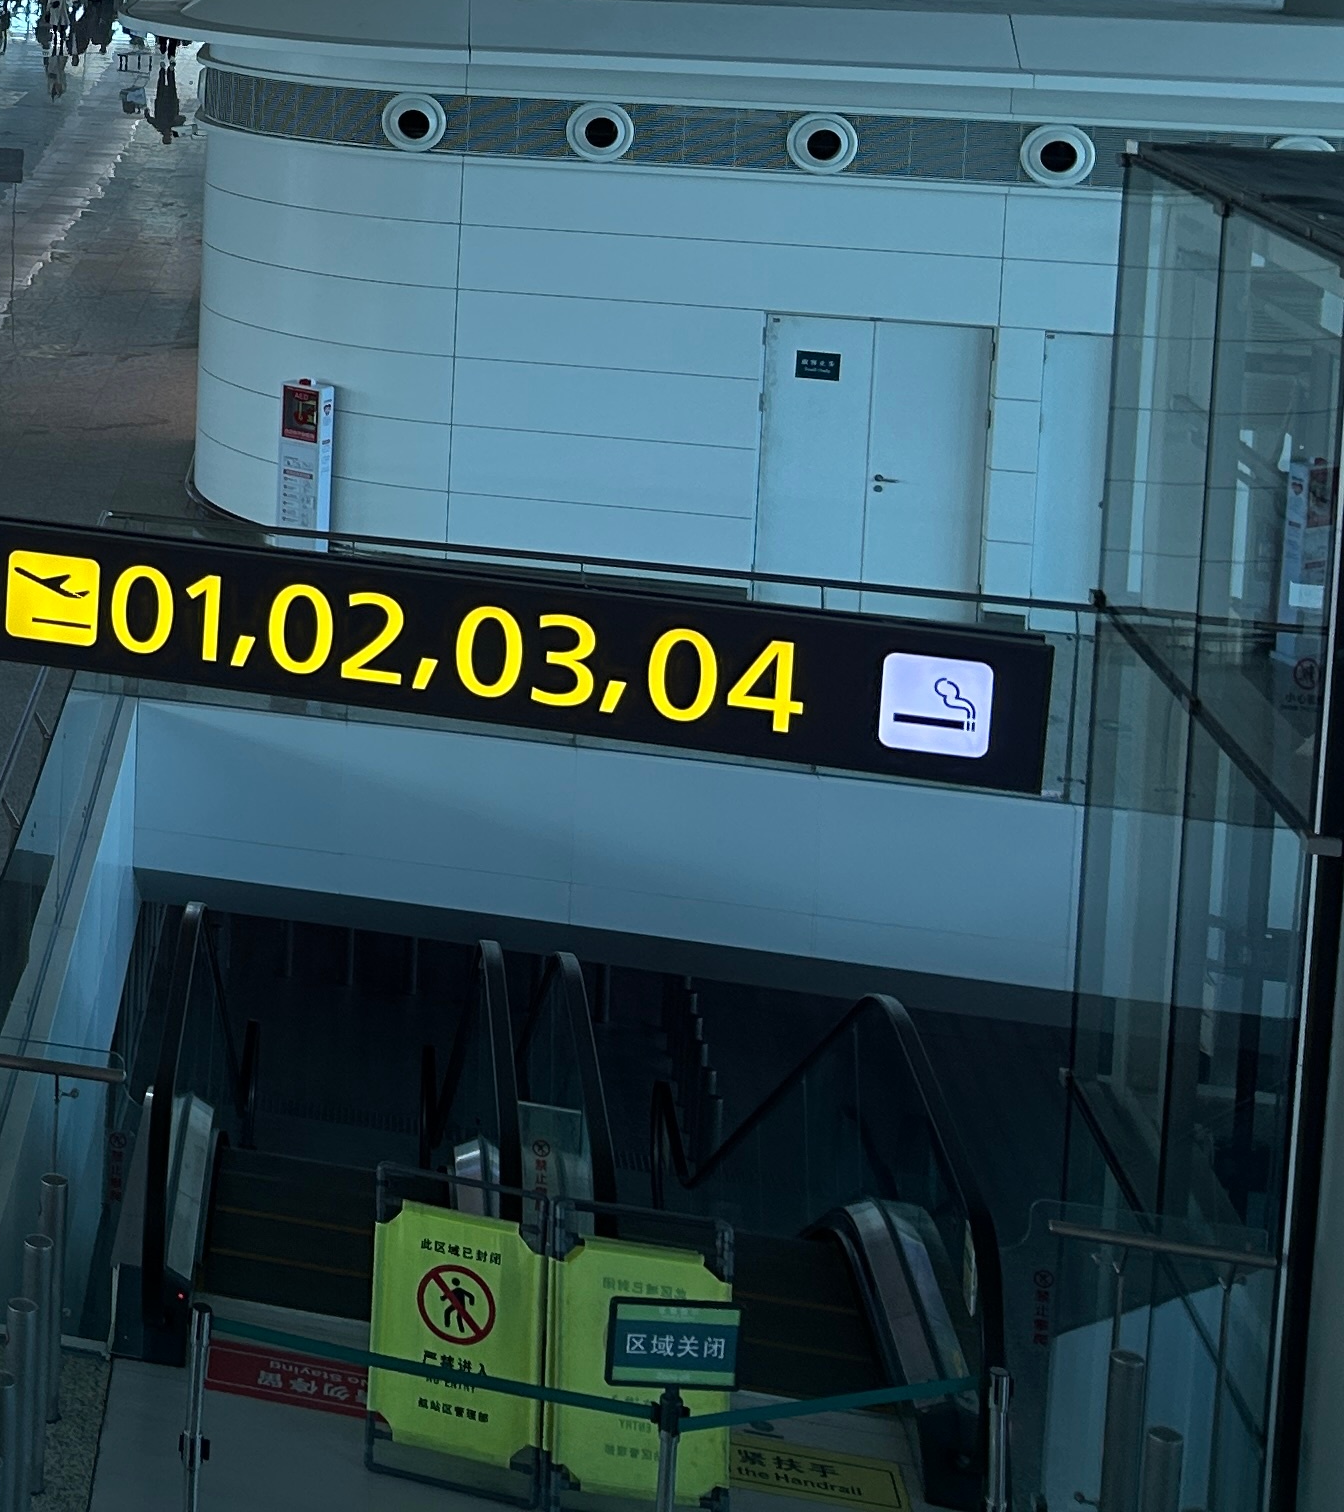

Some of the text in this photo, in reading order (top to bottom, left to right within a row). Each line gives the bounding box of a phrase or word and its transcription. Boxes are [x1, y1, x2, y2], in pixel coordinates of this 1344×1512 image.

[294, 392, 309, 400] AED
[111, 564, 806, 733] 01,02,03,04
[420, 1238, 502, 1265] 此区域已封闭
[625, 1333, 726, 1360] 区域关闭
[269, 1361, 343, 1383] Staying
[417, 1397, 489, 1423] 航站区管理部
[738, 1466, 863, 1497] the Handrail
